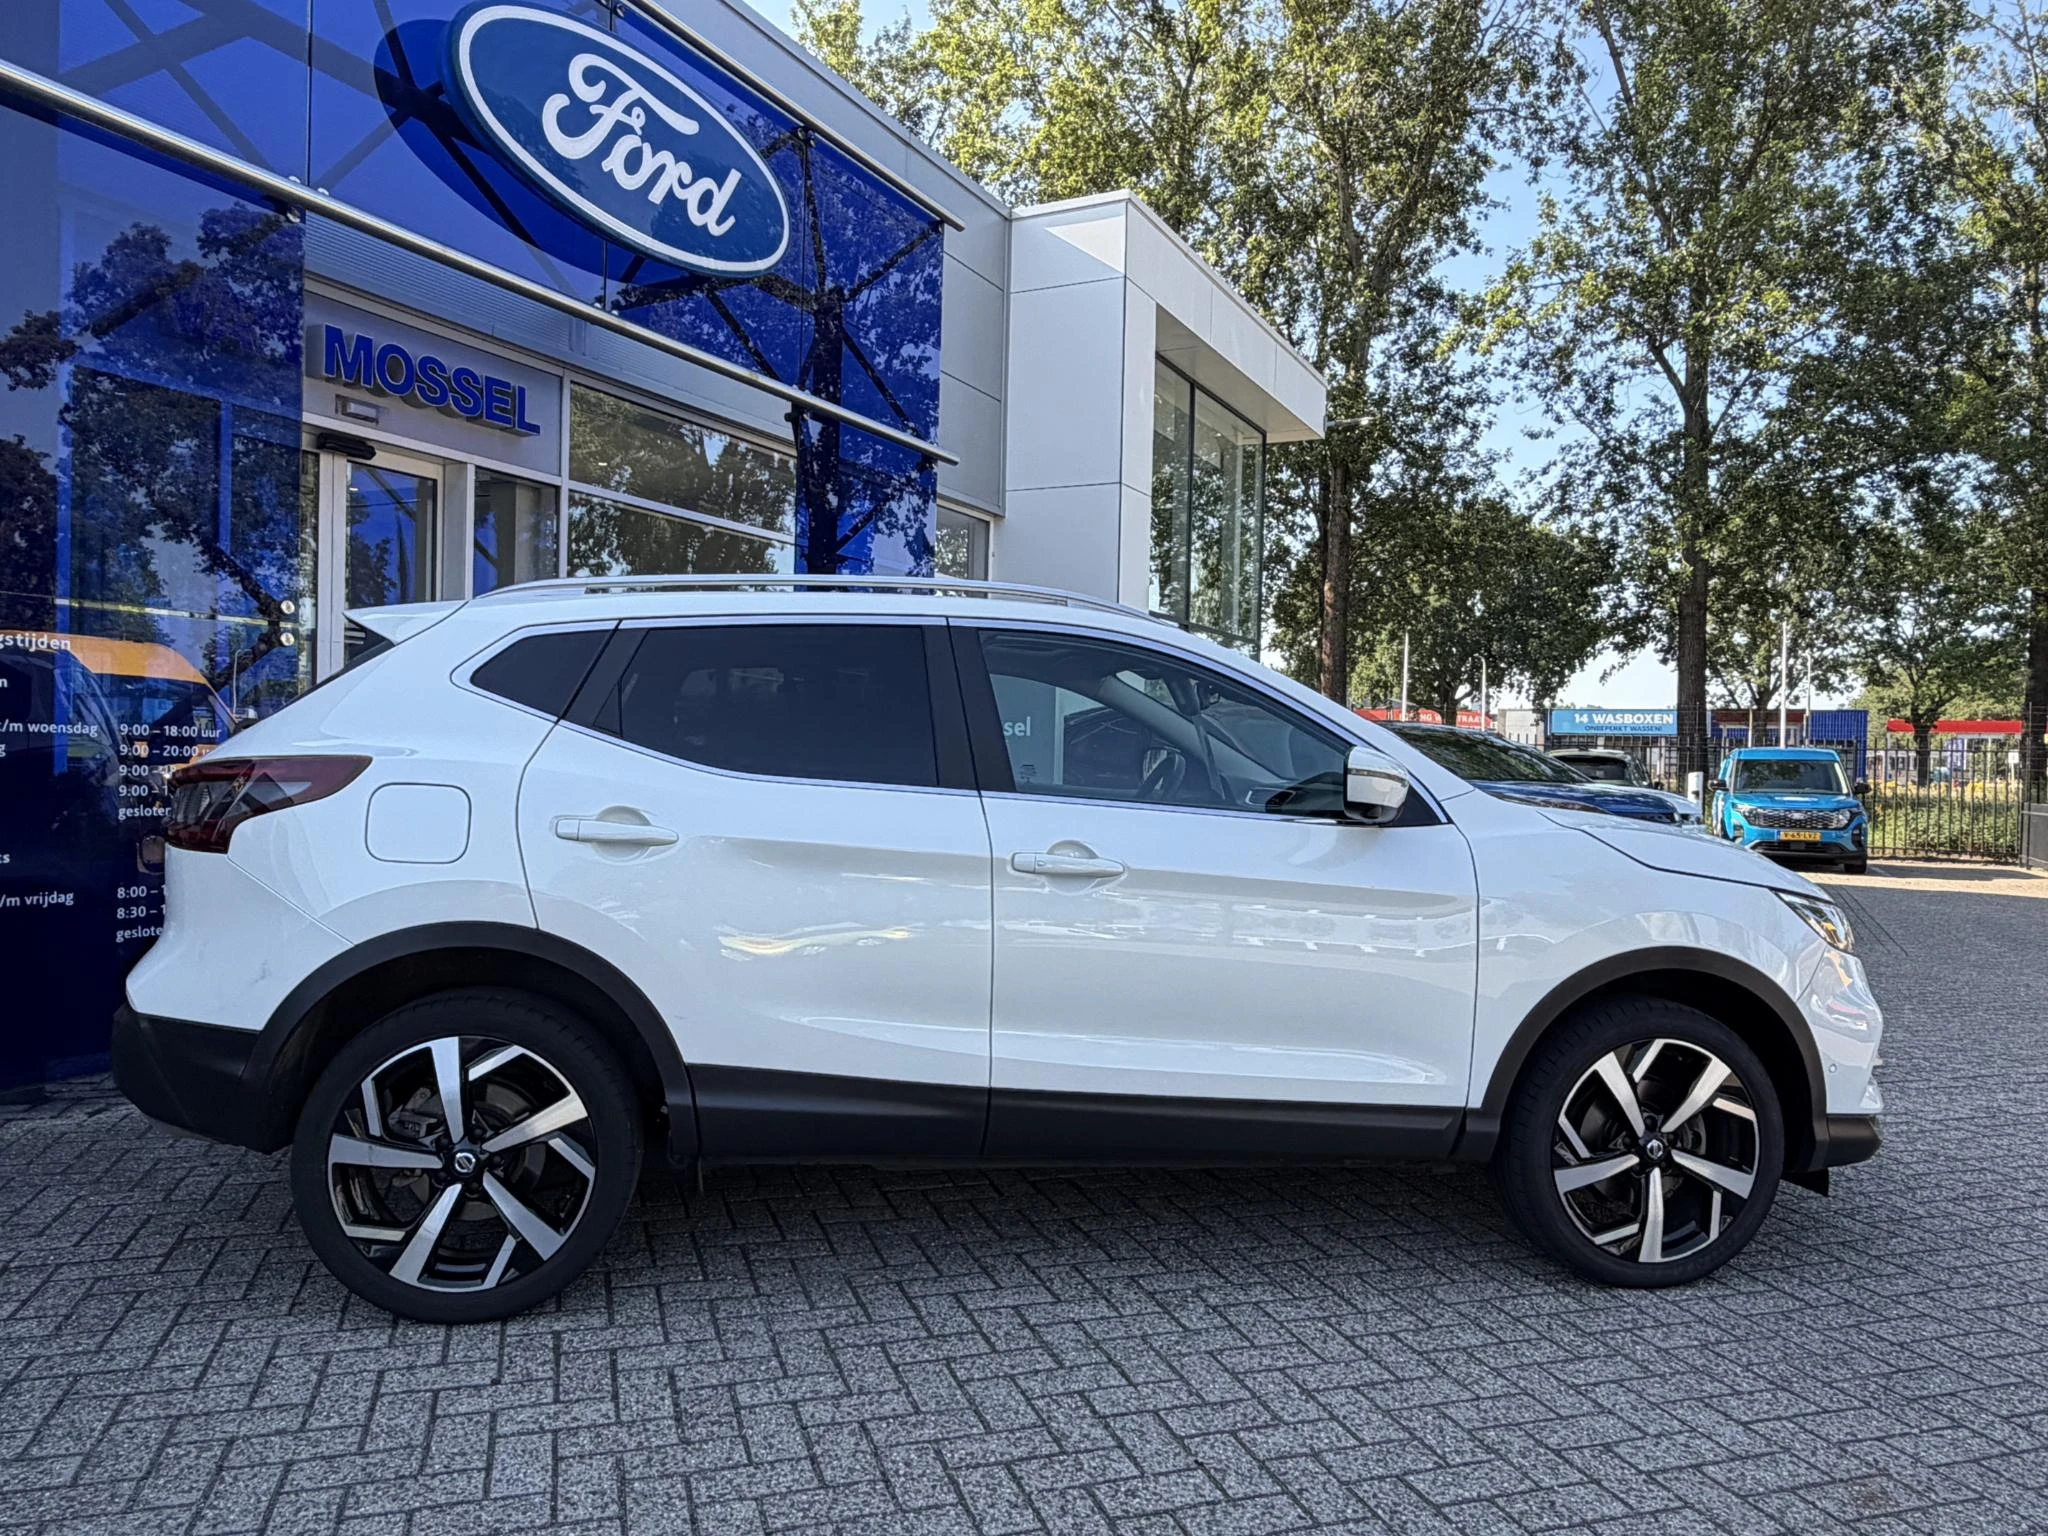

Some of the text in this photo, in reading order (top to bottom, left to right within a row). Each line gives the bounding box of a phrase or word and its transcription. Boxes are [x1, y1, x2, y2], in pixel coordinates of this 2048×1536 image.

[542, 53, 742, 237] Ford
[323, 323, 541, 436] MOSSEL
[1574, 713, 1674, 724] 14 WASBOXEN
[28, 721, 98, 737] woensdag
[120, 723, 149, 736] 9:00
[163, 725, 198, 737] 18:00
[201, 729, 222, 738] uur
[119, 744, 149, 756] 9:00
[163, 745, 199, 757] 20:00
[119, 764, 149, 776] 9:00
[118, 785, 149, 797] 9:00
[24, 890, 74, 908] vrijdag
[117, 885, 147, 899] 8:00
[116, 905, 147, 919] 8:30
[115, 925, 163, 943] geslote
